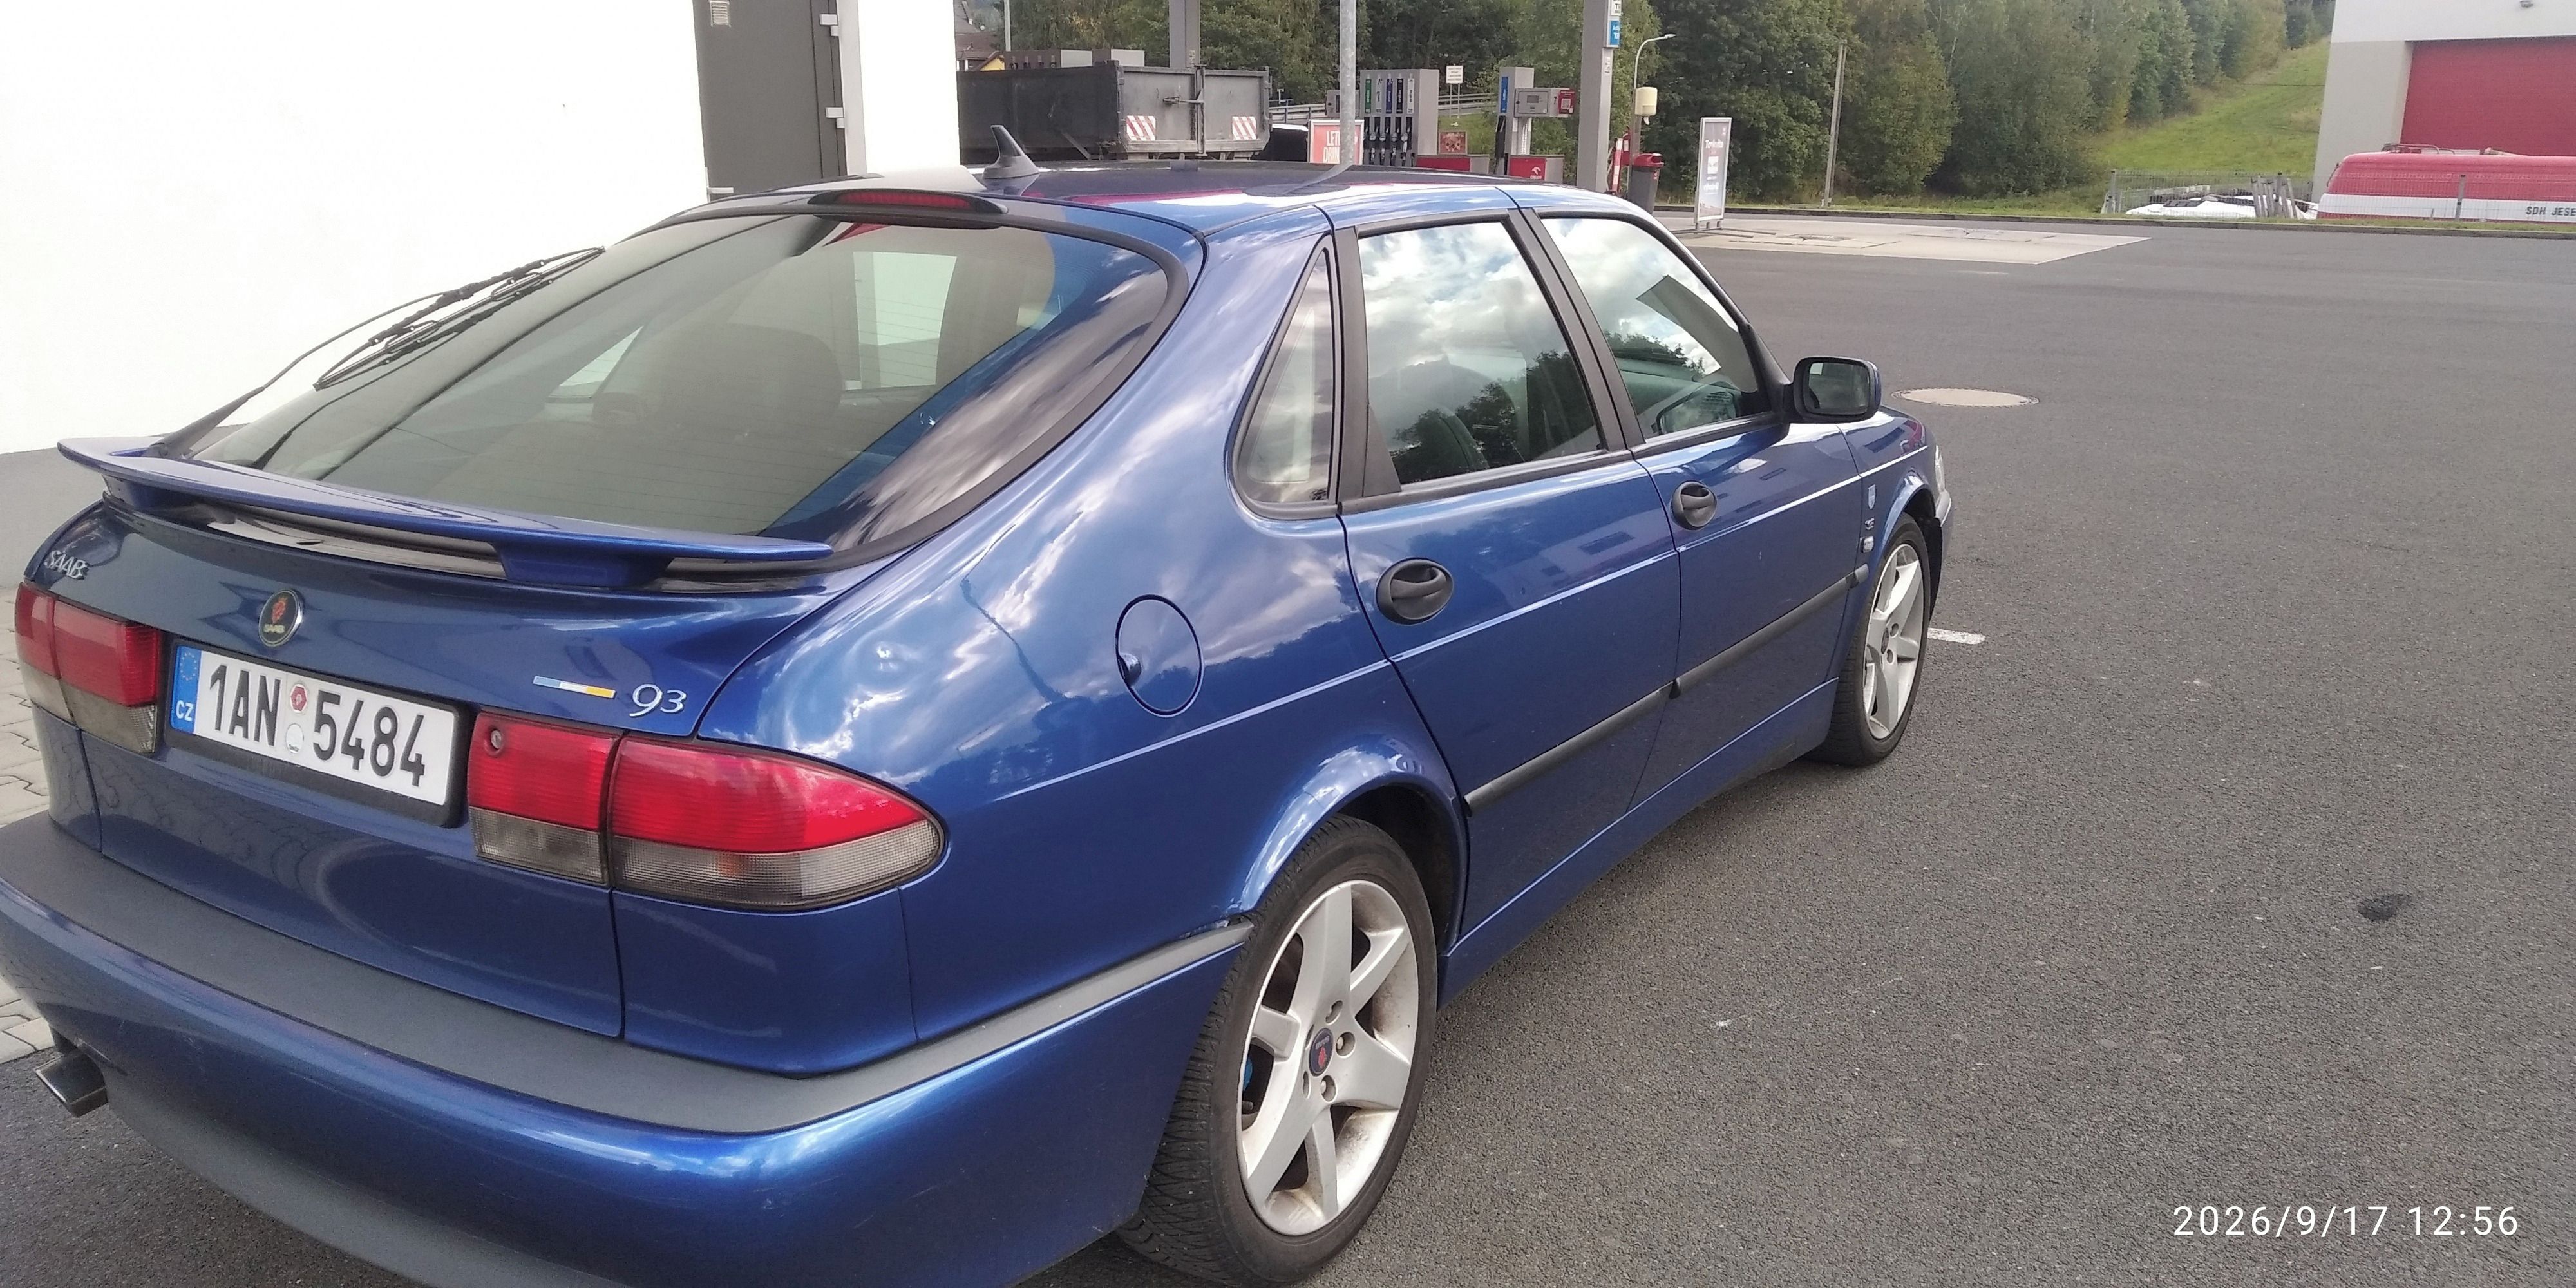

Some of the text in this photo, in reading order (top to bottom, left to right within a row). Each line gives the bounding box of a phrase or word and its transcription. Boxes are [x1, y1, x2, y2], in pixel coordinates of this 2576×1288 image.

[2526, 206, 2546, 215] SDH
[44, 550, 87, 578] SAAB
[263, 623, 285, 634] SAAB
[176, 699, 193, 722] CZ
[209, 665, 425, 788] 1AN 5484
